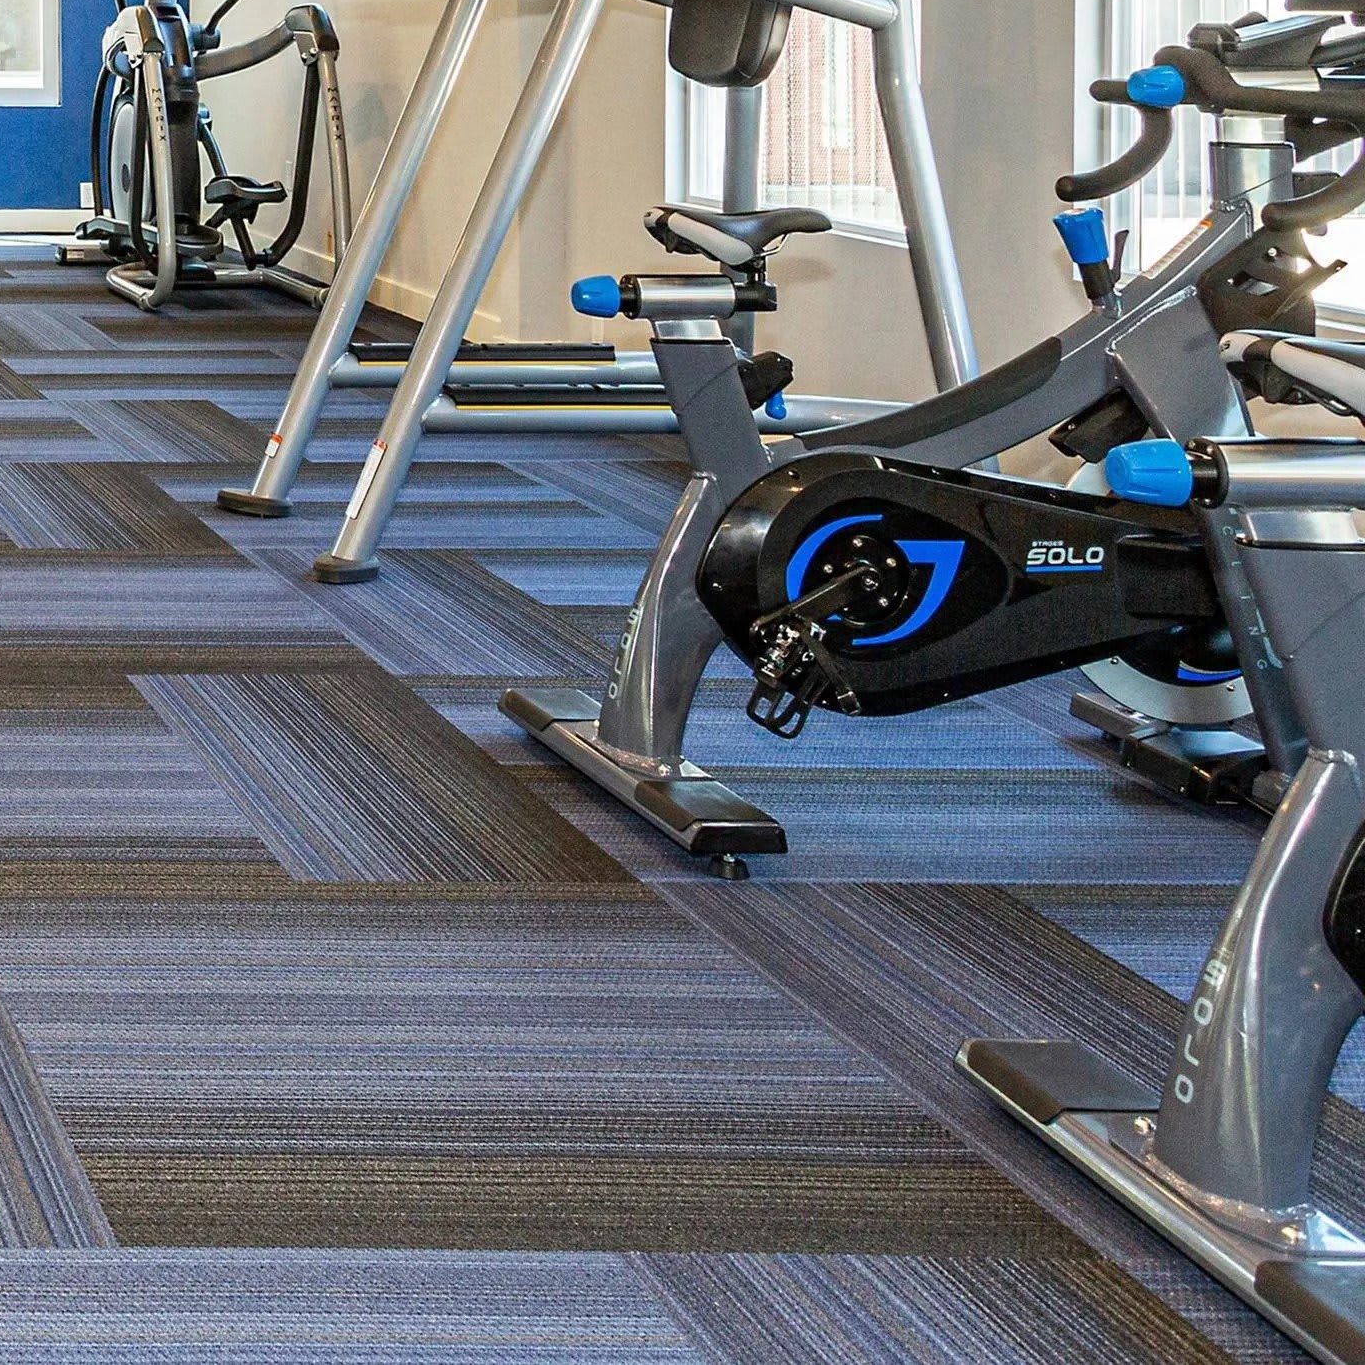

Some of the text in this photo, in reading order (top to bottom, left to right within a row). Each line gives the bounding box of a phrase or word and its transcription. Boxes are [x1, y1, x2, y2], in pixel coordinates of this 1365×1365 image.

[151, 88, 167, 141] MATRIX
[327, 87, 343, 140] MATRIX
[1026, 546, 1105, 565] SOLO
[609, 608, 640, 700] SOLO
[1174, 958, 1227, 1104] SOLO
